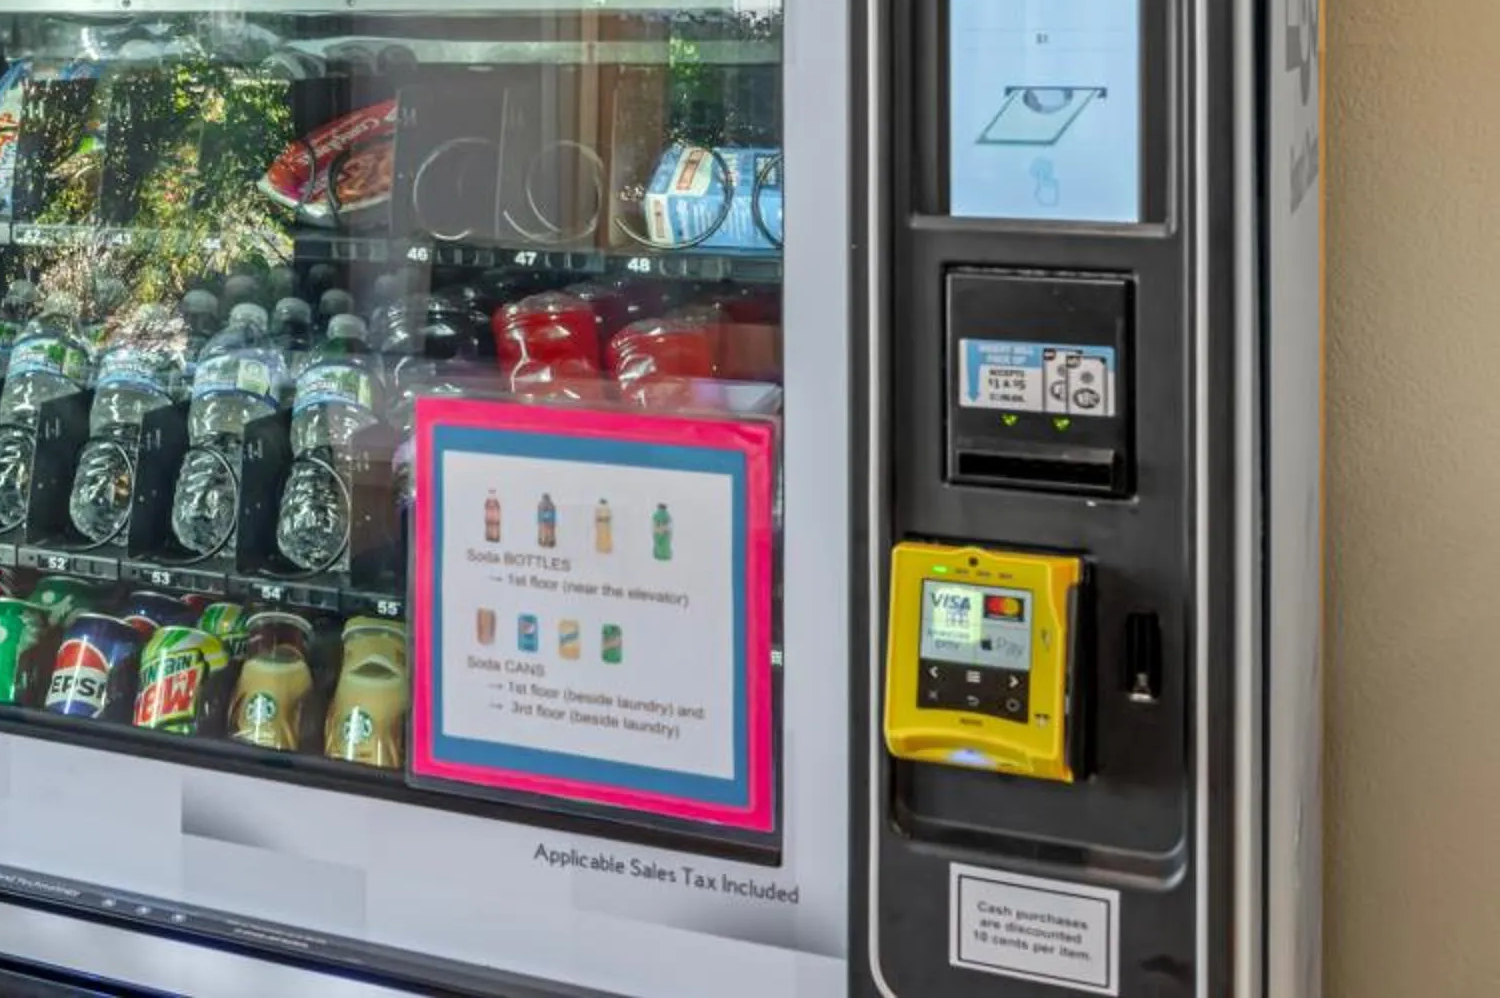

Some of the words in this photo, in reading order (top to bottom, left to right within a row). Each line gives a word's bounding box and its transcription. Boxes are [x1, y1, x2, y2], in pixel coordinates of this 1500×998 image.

[407, 247, 428, 262] 46
[514, 251, 536, 266] 47
[627, 258, 650, 273] 48
[48, 557, 66, 571] 52
[466, 547, 501, 566] Soda
[503, 551, 572, 572] BOTTLES
[151, 570, 170, 586] 53
[261, 585, 281, 600] 54
[507, 574, 527, 590] 1st
[529, 576, 559, 593] floor
[562, 579, 599, 599] (near
[601, 582, 624, 597] the
[627, 585, 690, 609] elevator)
[930, 591, 971, 611] VISA
[377, 601, 398, 616] 55
[467, 655, 501, 672] Soda
[503, 660, 546, 678] CANS
[51, 675, 106, 699] EPSI
[508, 680, 528, 696] 1st
[530, 682, 560, 700] floor
[563, 685, 614, 707] (beside
[617, 692, 675, 718] laundry)
[677, 704, 706, 721] and
[510, 701, 534, 717] 3rd
[536, 703, 566, 721] floor
[570, 706, 620, 729] (beside
[623, 714, 681, 740] laundry)
[533, 842, 626, 876] Applicable
[629, 858, 677, 885] Sales
[681, 866, 718, 892] Tax
[721, 876, 800, 905] Included
[977, 900, 1013, 917] Cash
[1015, 909, 1089, 931] purchases
[980, 918, 1002, 930] are
[1004, 921, 1083, 945] discounted
[973, 929, 989, 943] 10
[992, 934, 1029, 951] cents
[1032, 942, 1055, 958] per
[1059, 945, 1092, 961] item.
